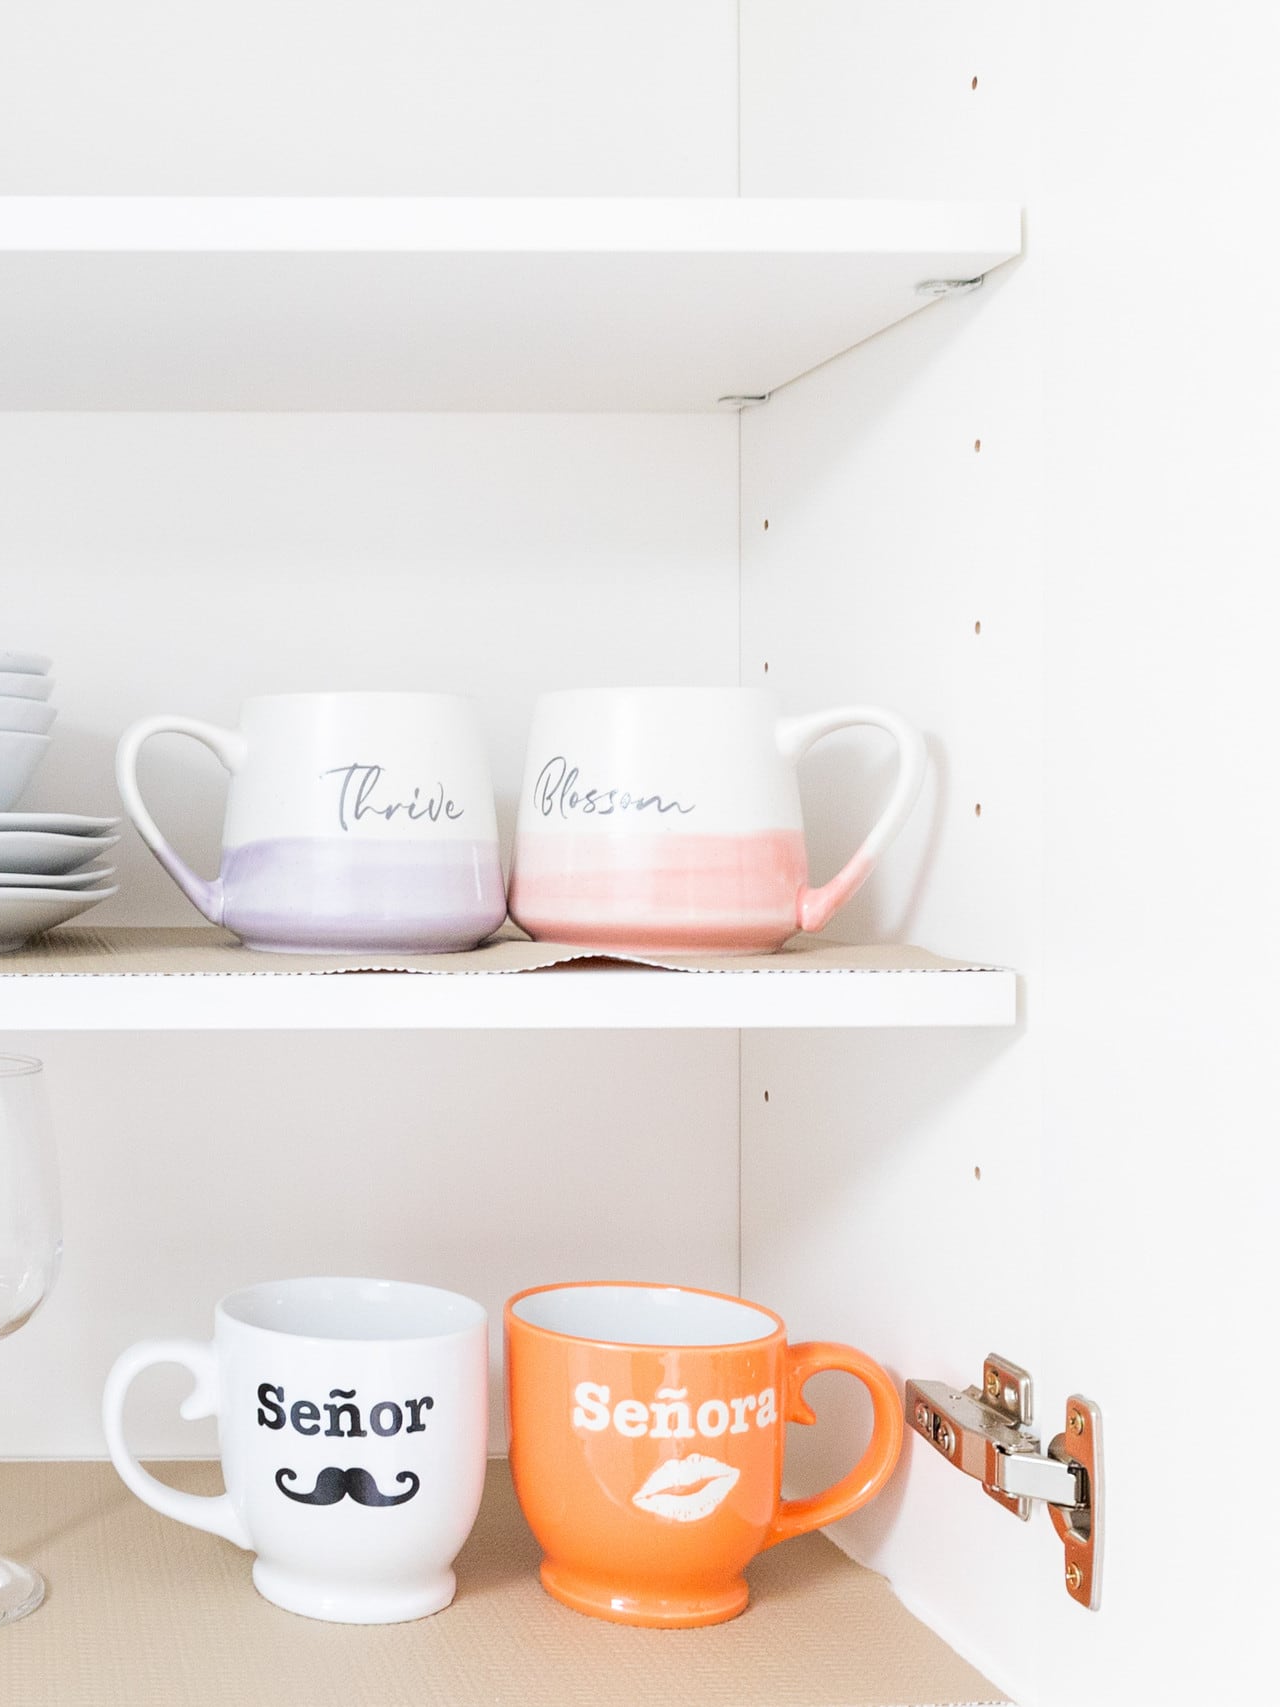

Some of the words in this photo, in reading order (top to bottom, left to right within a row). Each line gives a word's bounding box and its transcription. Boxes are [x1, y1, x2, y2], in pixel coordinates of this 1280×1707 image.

[326, 763, 464, 831] Thrive
[534, 756, 696, 819] Blossom
[257, 1383, 434, 1437] Señor
[572, 1381, 778, 1439] Señora
